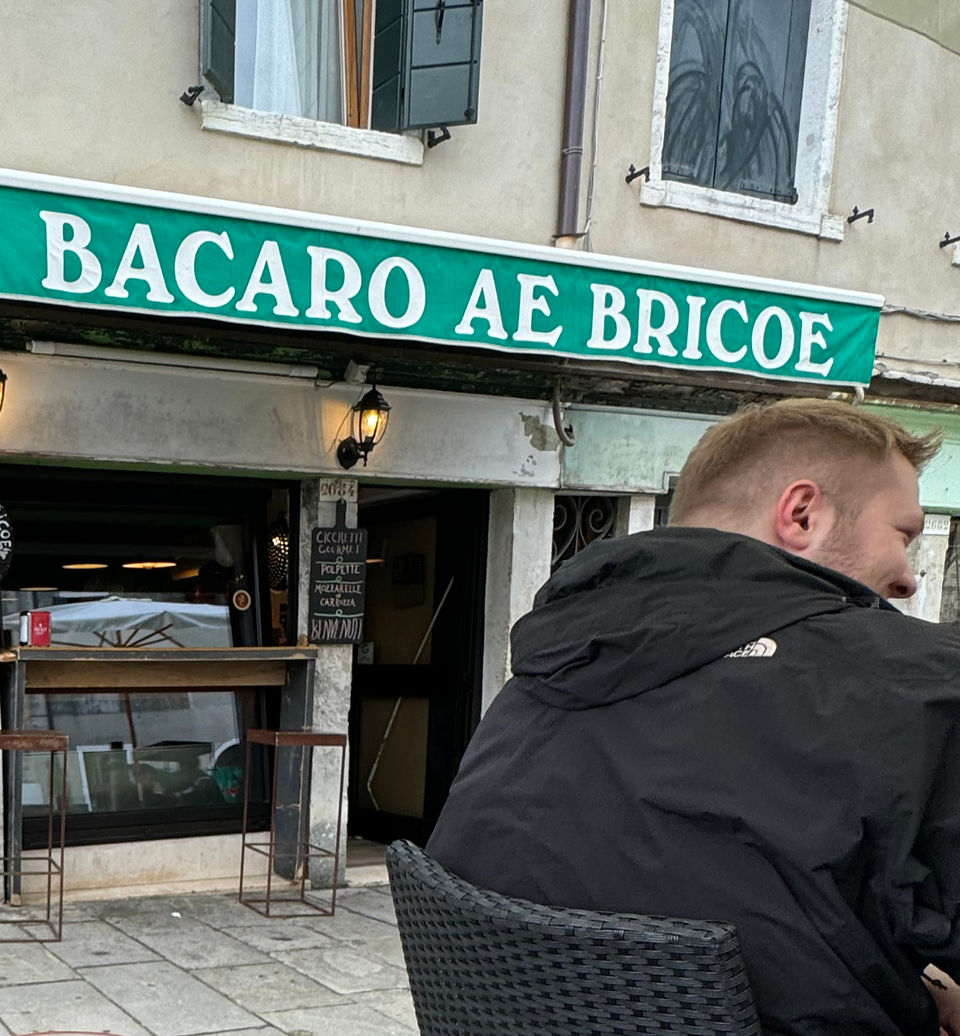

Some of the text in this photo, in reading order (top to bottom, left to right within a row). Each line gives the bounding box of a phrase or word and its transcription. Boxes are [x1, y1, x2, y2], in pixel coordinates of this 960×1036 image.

[40, 210, 834, 377] BACARO AE BRICOE
[321, 564, 361, 575] POLPETTE
